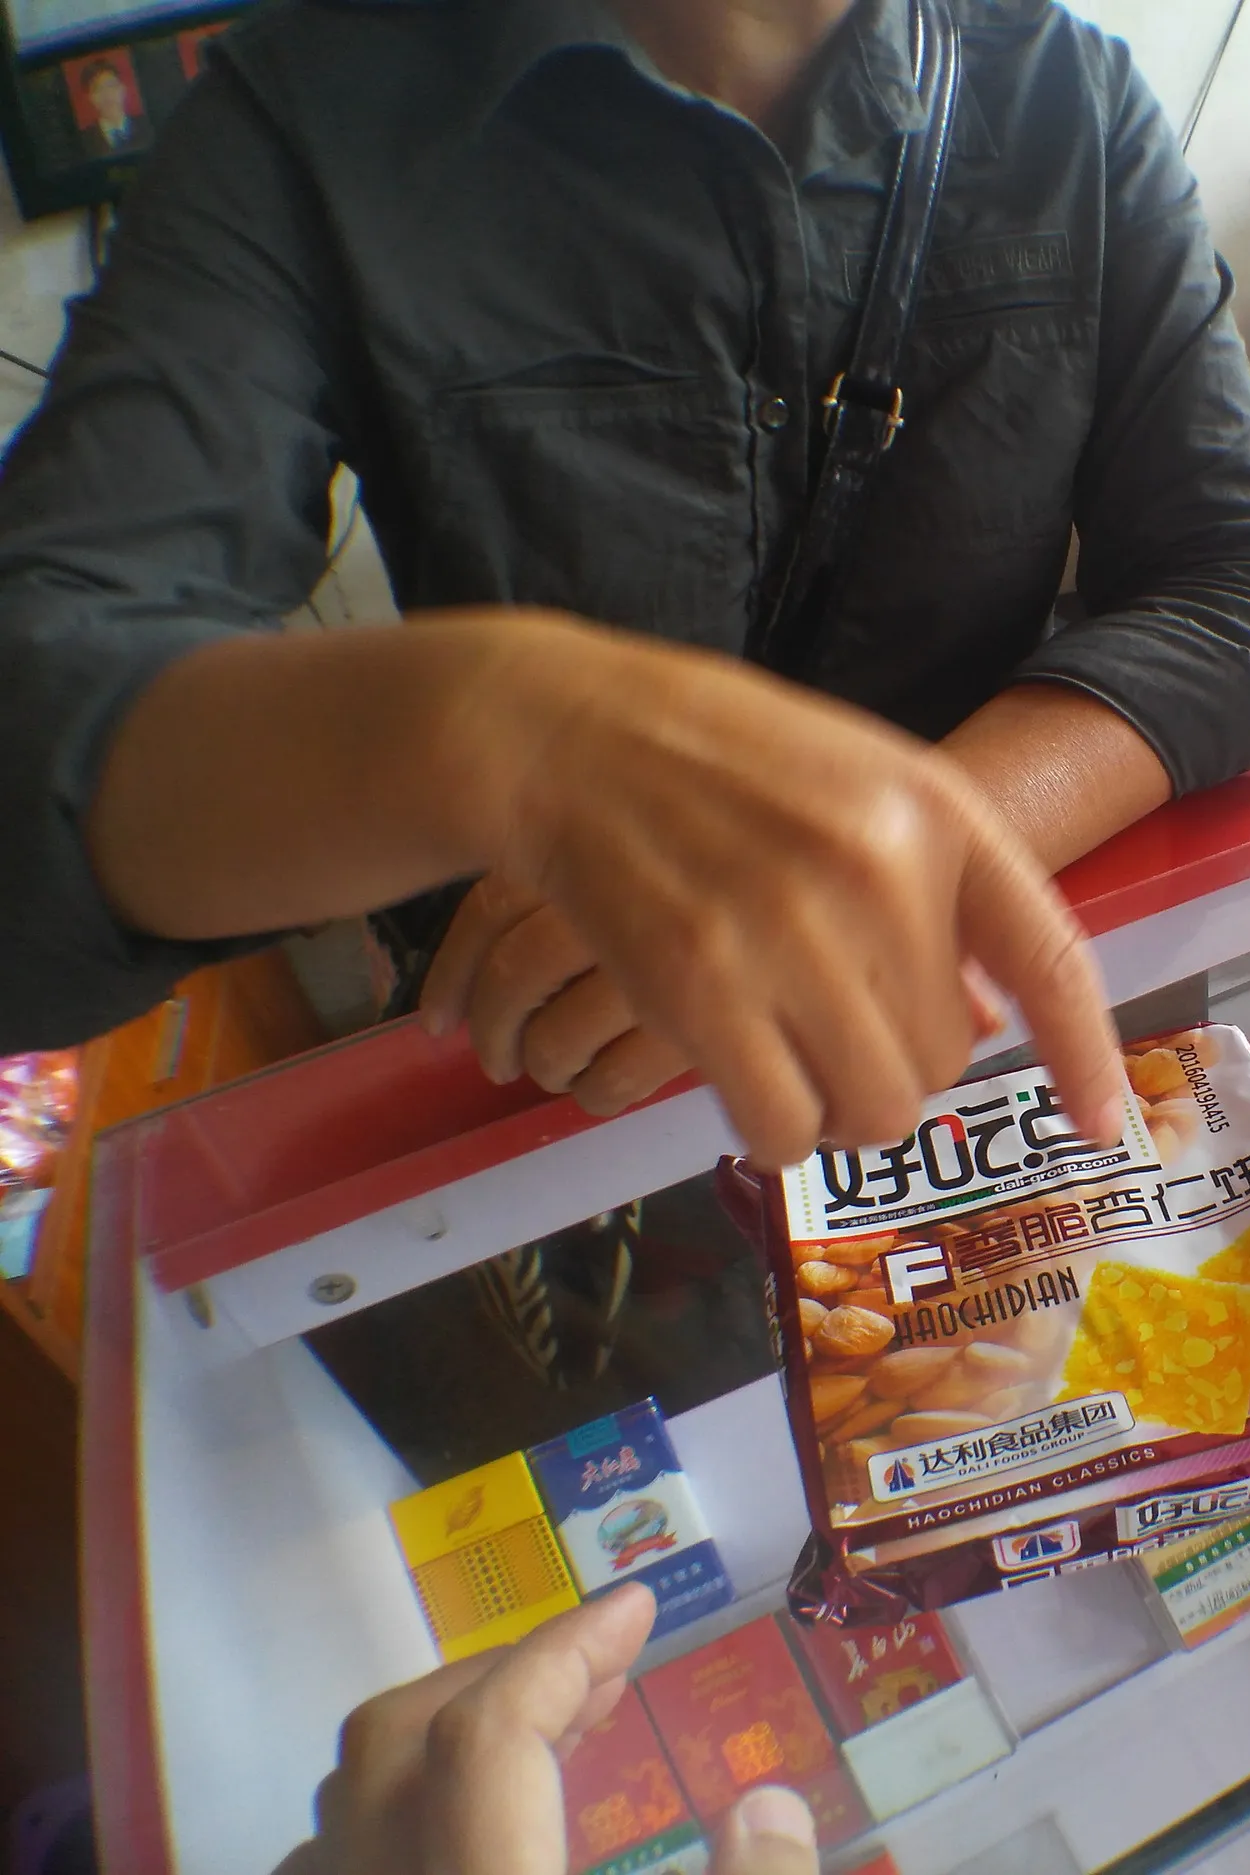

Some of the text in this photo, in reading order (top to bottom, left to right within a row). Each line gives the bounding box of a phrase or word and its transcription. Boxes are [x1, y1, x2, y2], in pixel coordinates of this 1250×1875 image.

[1175, 1043, 1231, 1134] 20160419A415
[816, 1085, 1125, 1213] 好吃点
[891, 1265, 1081, 1346] HAOCHIDIAN
[918, 1399, 1118, 1477] 达利食品集团
[958, 1431, 1085, 1476] DALI FOODS GROUP
[907, 1447, 1157, 1530] HAOCHIDIAN CLASSICS
